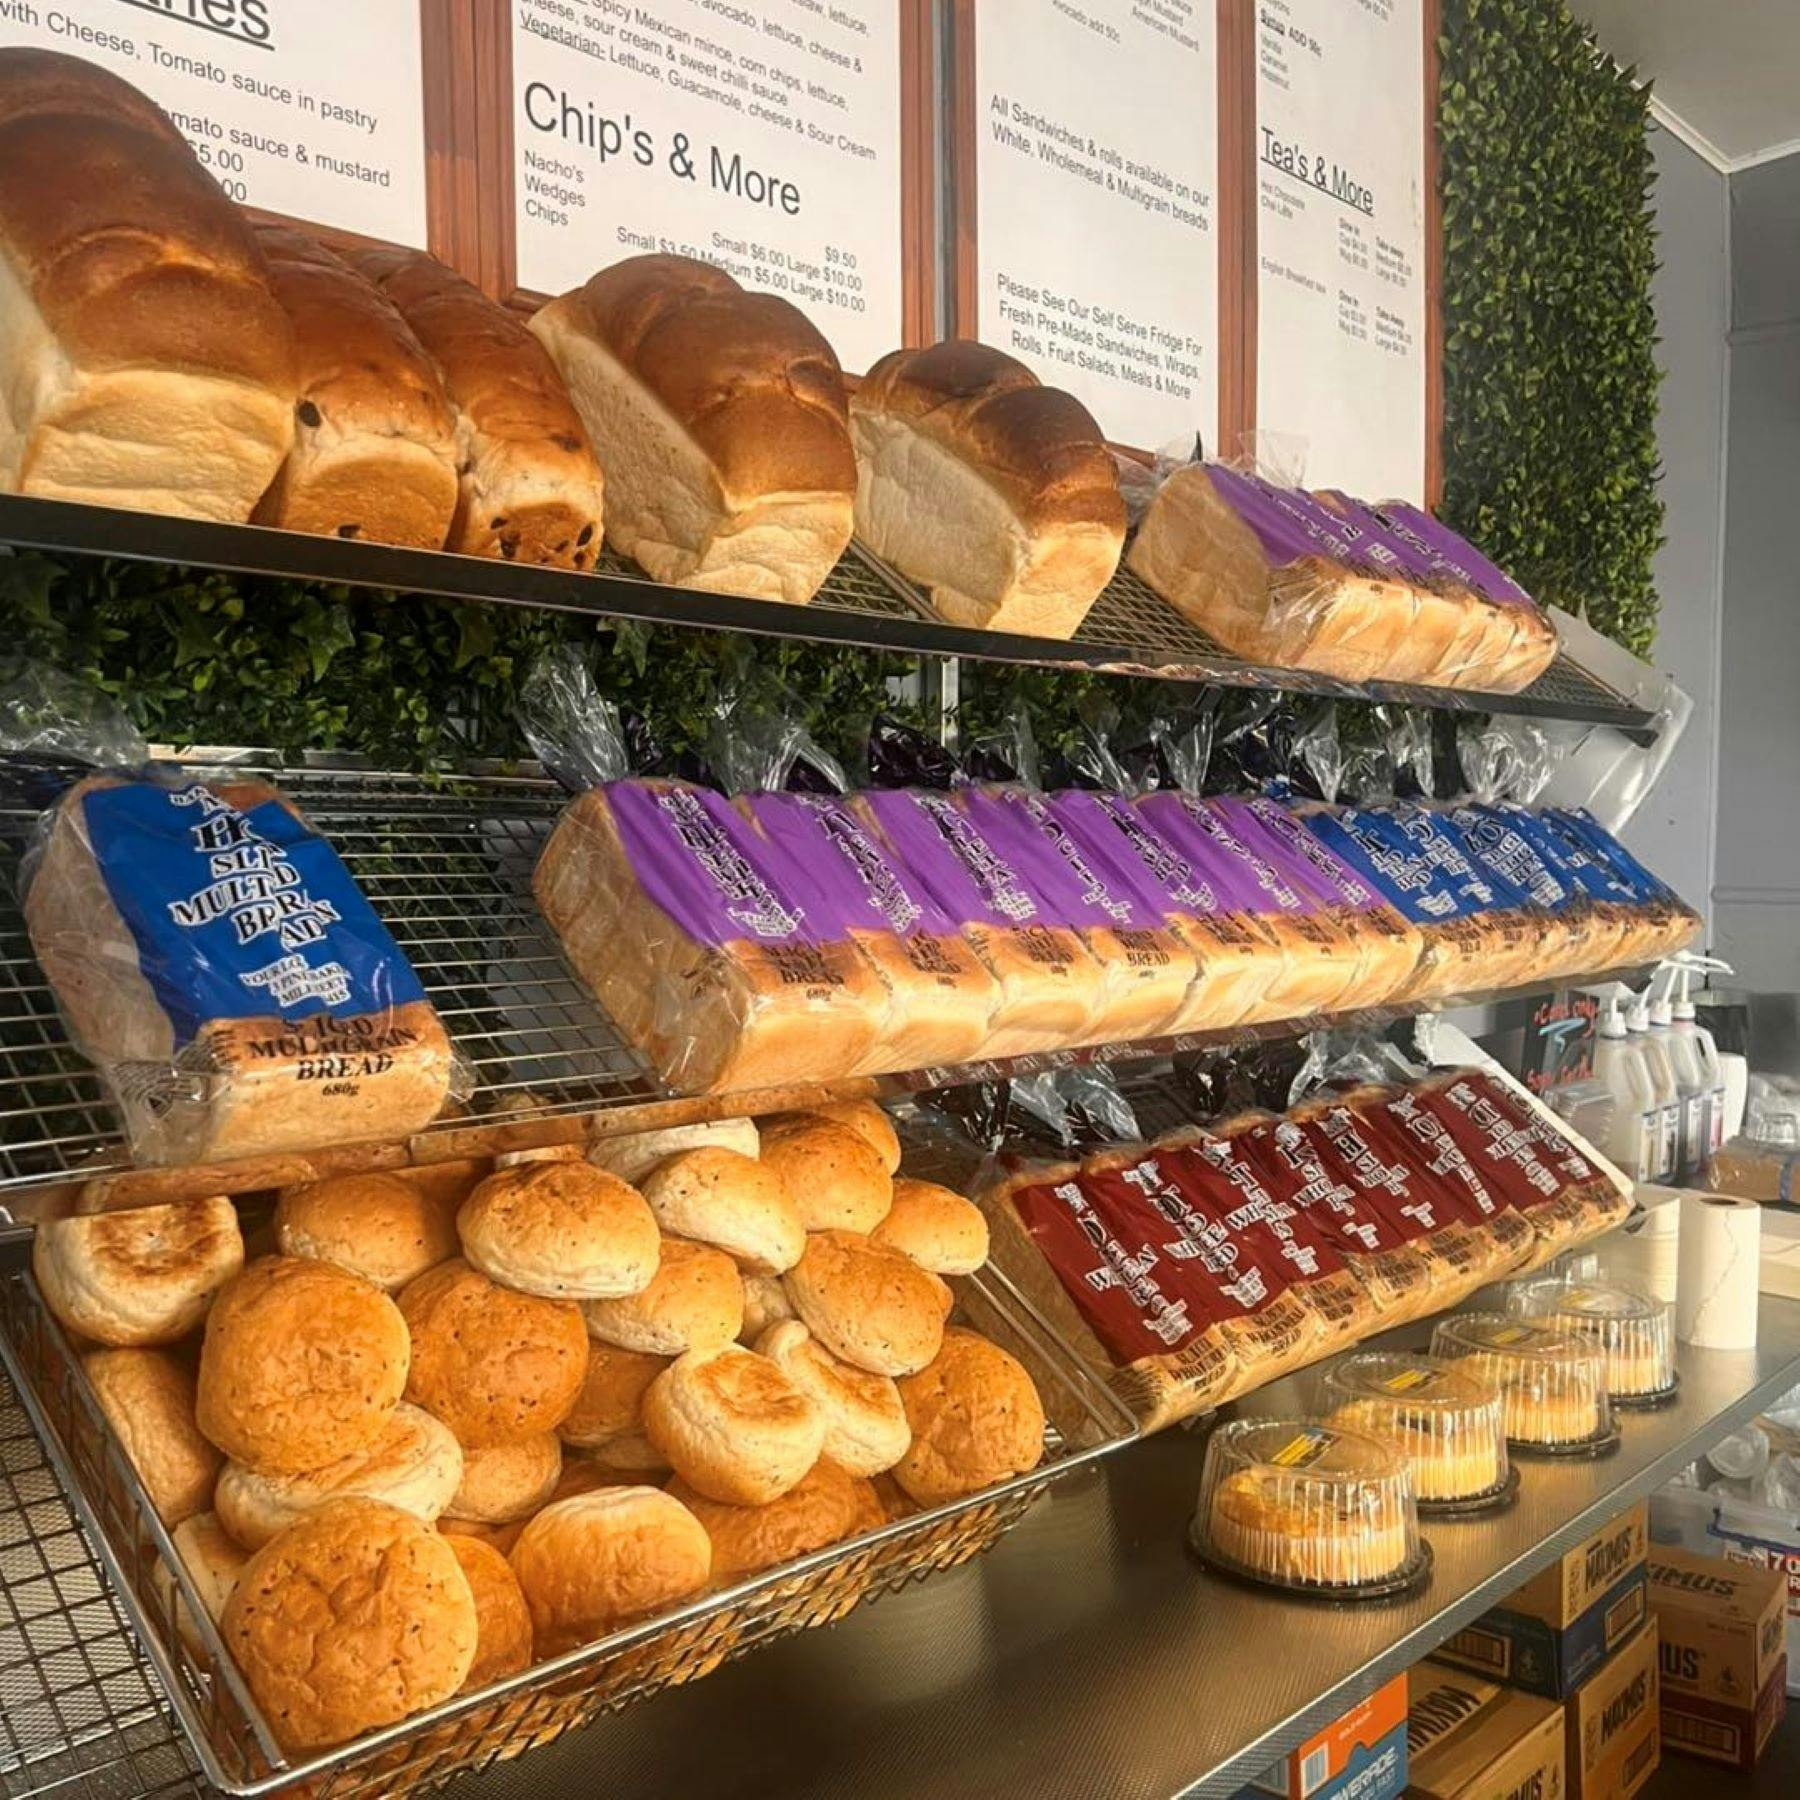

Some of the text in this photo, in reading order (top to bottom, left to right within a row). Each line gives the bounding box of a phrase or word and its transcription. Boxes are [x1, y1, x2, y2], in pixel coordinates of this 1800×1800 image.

[584, 15, 615, 36] sour
[619, 28, 662, 57] cream
[666, 45, 676, 61] &
[680, 54, 717, 79] sweet
[752, 82, 788, 106] sauce
[635, 9, 691, 43] Mexican
[694, 37, 736, 65] mince,
[763, 17, 806, 50] lettuce,
[809, 42, 850, 68] cheese
[148, 42, 226, 84] Tomato
[232, 72, 292, 104] sauce
[297, 90, 314, 113] in
[321, 101, 378, 134] pastry
[610, 46, 663, 82] Lettuce,
[668, 69, 745, 114] Guacamole,
[749, 103, 793, 129] cheese
[796, 120, 804, 134] &
[807, 123, 834, 144] Sour
[838, 135, 876, 160] Cream
[170, 111, 390, 188] mato sauce & mustard
[187, 139, 244, 172] 5.00
[525, 82, 800, 216] Chip's & More
[525, 150, 584, 183] Nacho's
[991, 94, 1210, 207] All Sandwiches & rolls available on our
[1260, 126, 1374, 213] Tea's & More
[525, 173, 585, 207] Wedges
[526, 199, 568, 226] Chips
[1038, 140, 1103, 186] Wholemeal
[1106, 172, 1116, 191] &
[1118, 178, 1170, 211] Multigrain
[1173, 203, 1209, 231] breads
[617, 226, 655, 250] Small
[755, 265, 788, 290] $5.00
[791, 279, 824, 302] Large
[827, 288, 866, 312] $10.00
[712, 232, 748, 255] Small
[787, 254, 820, 281] Large
[823, 267, 862, 292] $10.00
[825, 246, 857, 270] $9.50
[998, 273, 1203, 356] Please See Our Self Serve Fridge For
[1000, 300, 1034, 327] Fresh
[1038, 313, 1094, 346] Pre-Made
[1048, 341, 1076, 366] Fruit
[1121, 364, 1153, 389] Meals
[1155, 374, 1163, 391] &
[1165, 378, 1191, 400] More
[297, 1053, 395, 1080] BREAD
[321, 1083, 361, 1097] 680g
